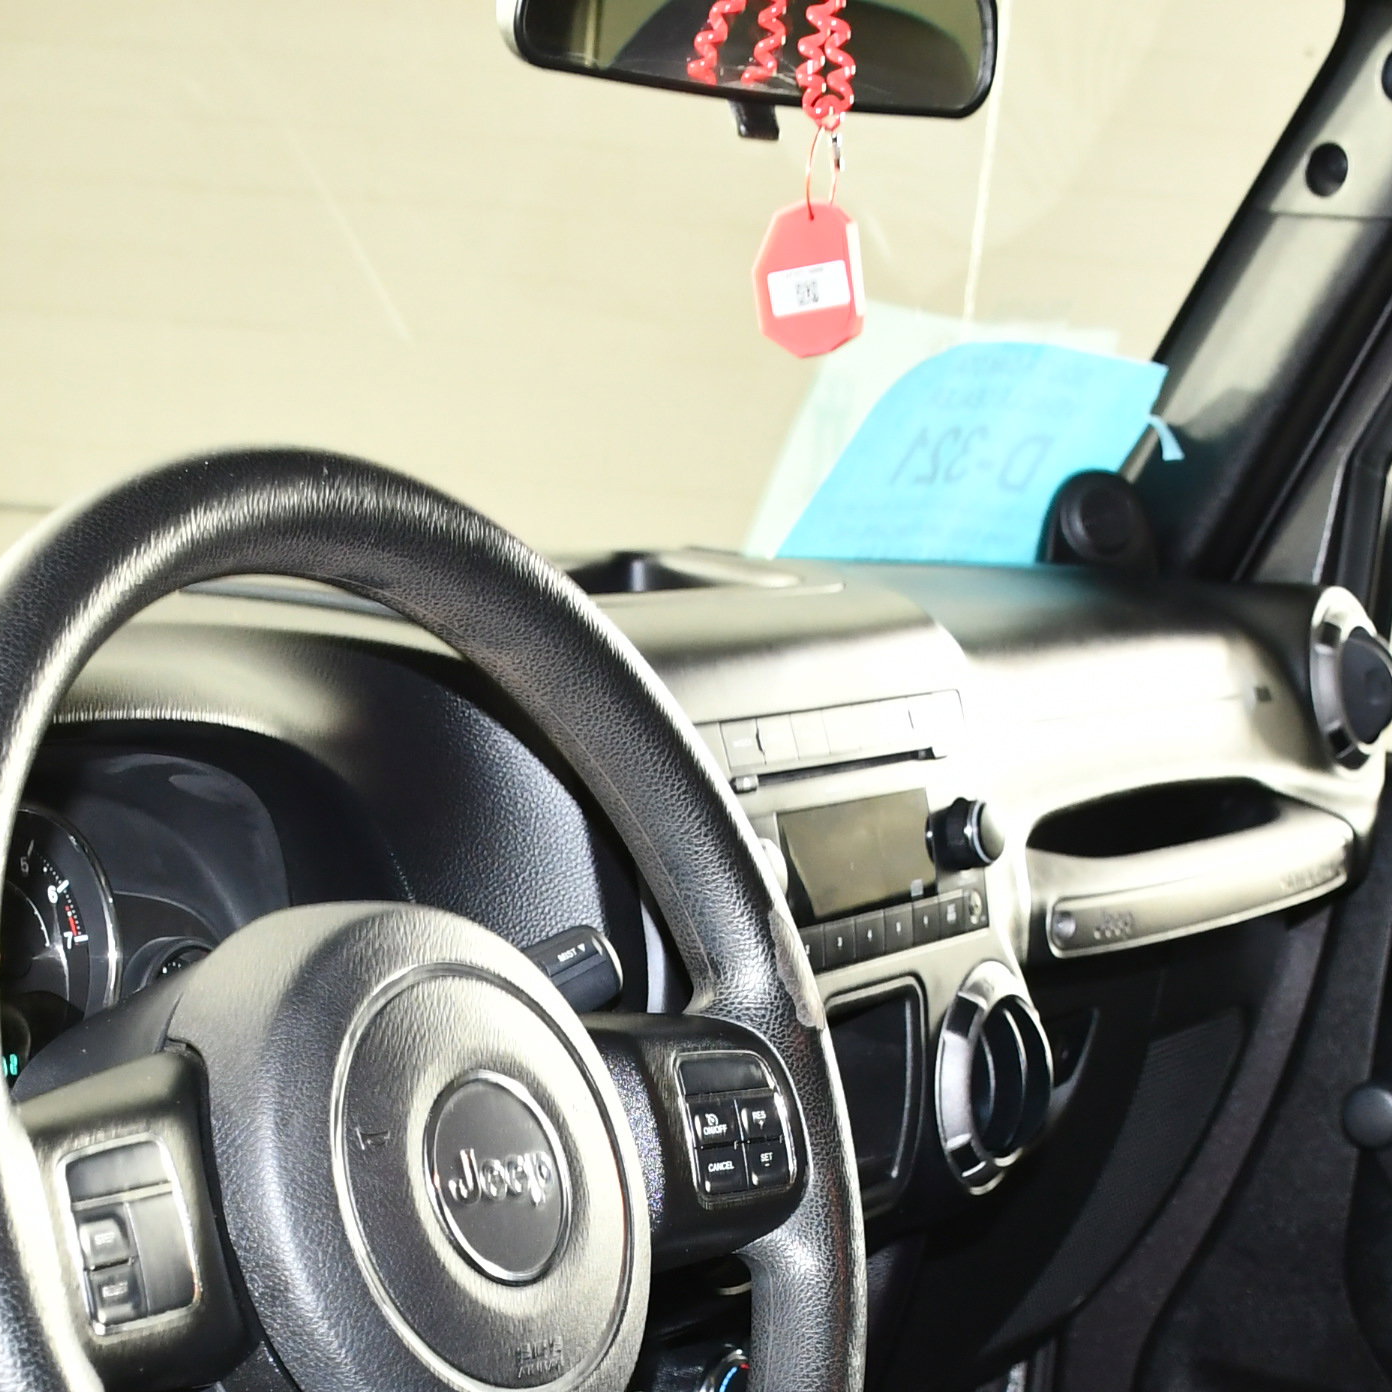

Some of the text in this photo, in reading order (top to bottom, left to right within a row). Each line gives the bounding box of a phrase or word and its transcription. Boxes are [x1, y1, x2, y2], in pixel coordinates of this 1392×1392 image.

[47, 885, 58, 903] 6
[63, 931, 73, 949] 7
[760, 1152, 773, 1162] SET
[708, 1160, 735, 1173] CANCEL
[447, 1147, 554, 1210] Jeep
